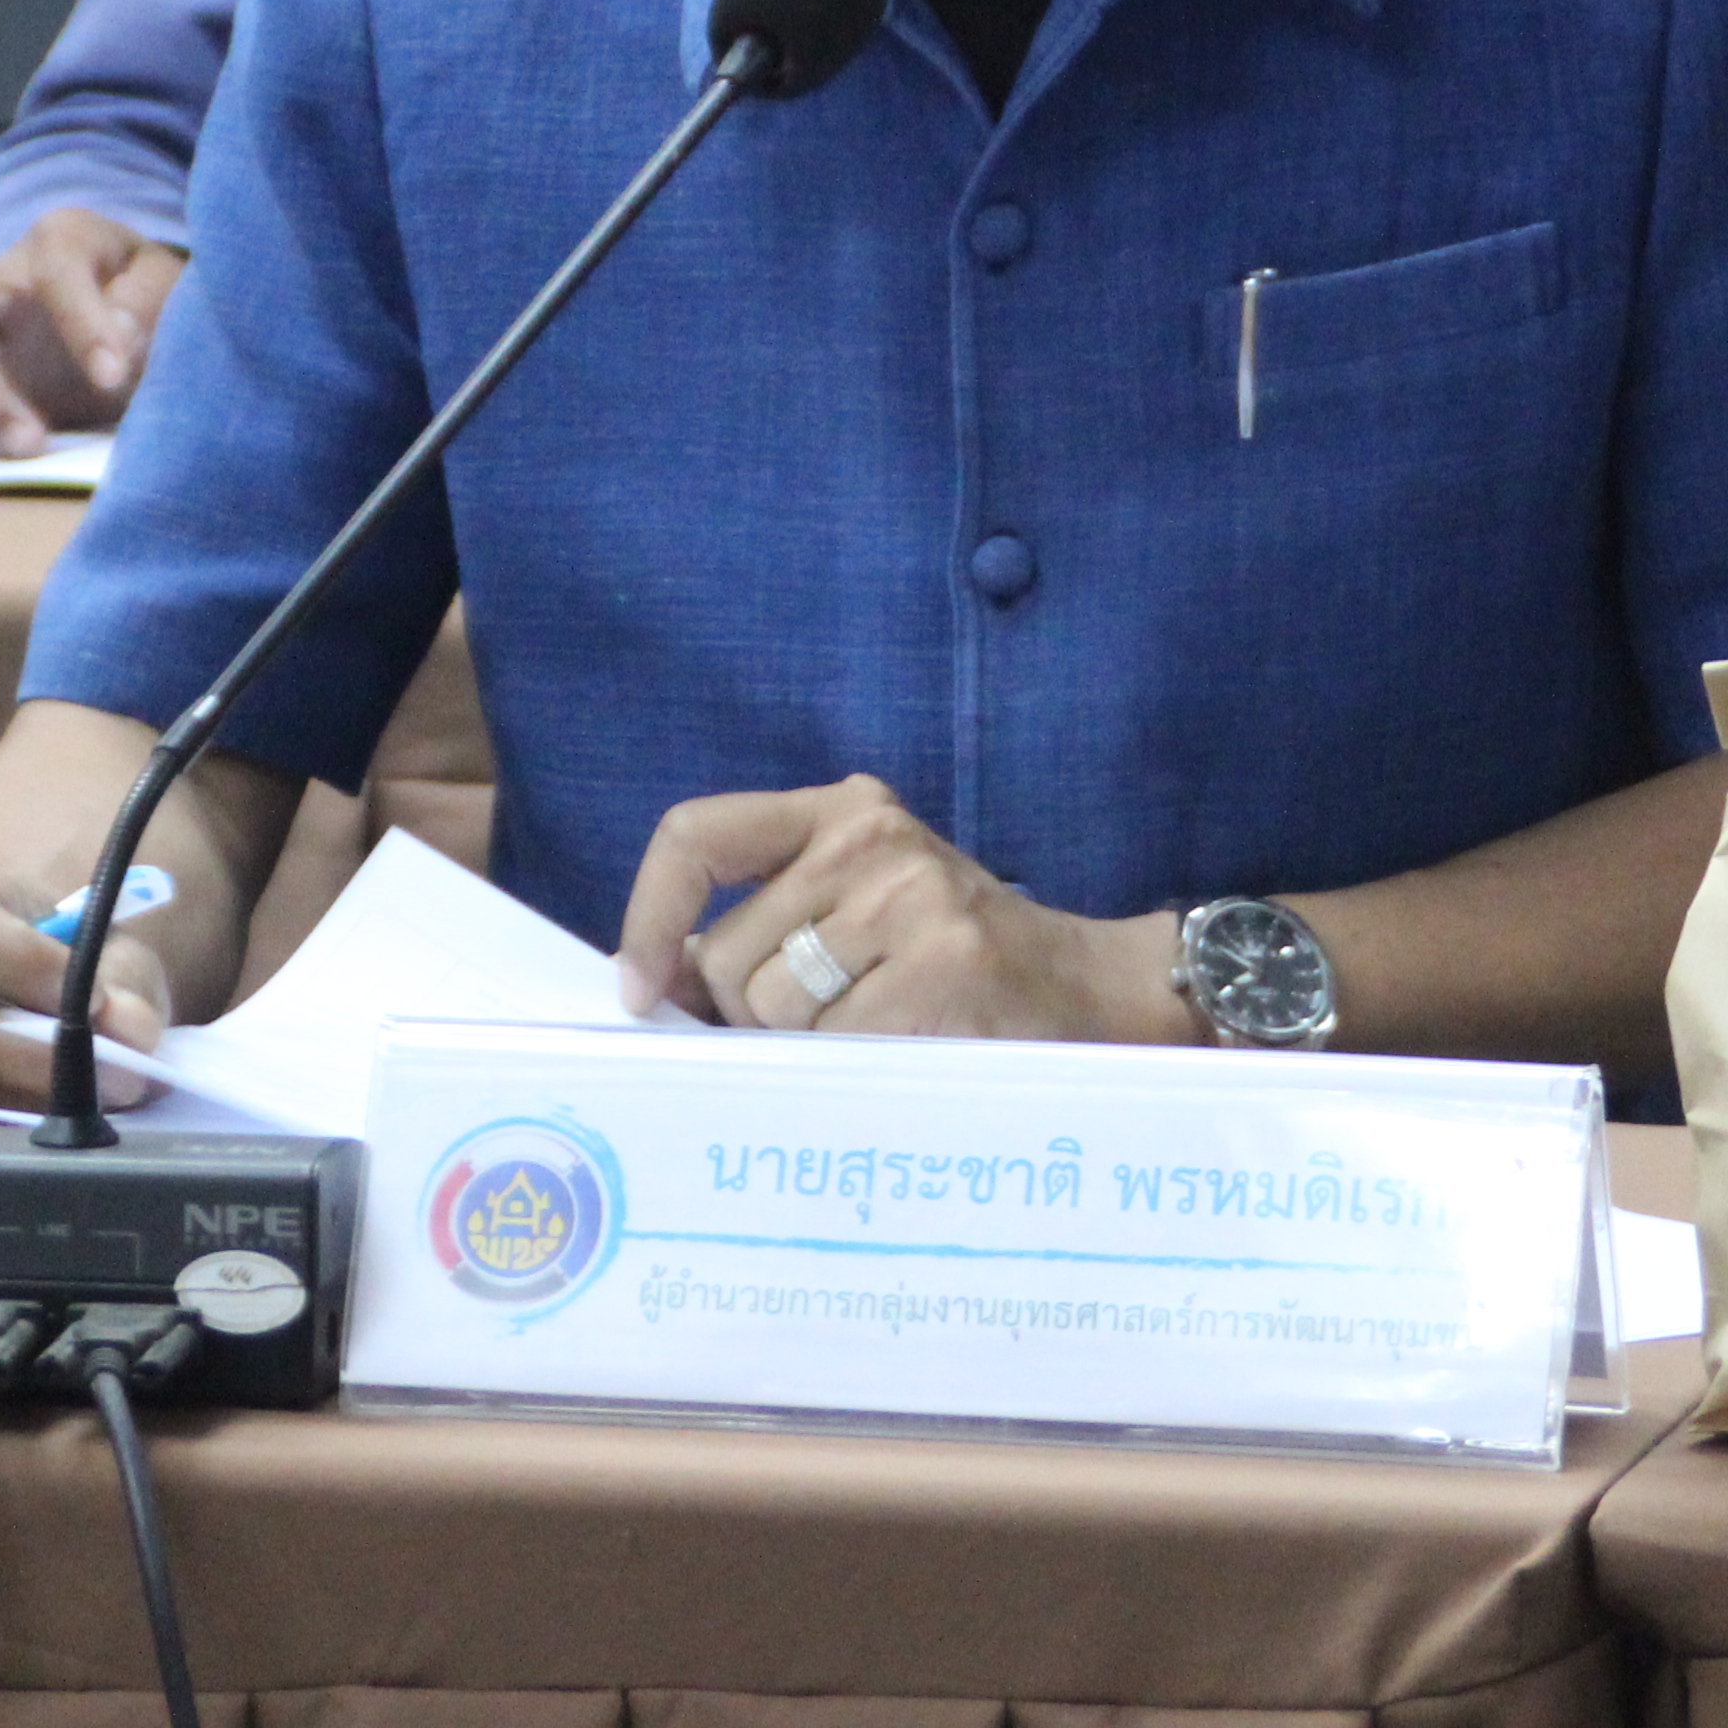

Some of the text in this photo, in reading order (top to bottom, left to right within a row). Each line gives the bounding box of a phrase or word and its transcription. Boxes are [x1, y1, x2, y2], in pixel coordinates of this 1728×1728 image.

[706, 1136, 1084, 1225] นายสุระชาติ
[183, 1202, 301, 1238] NPE
